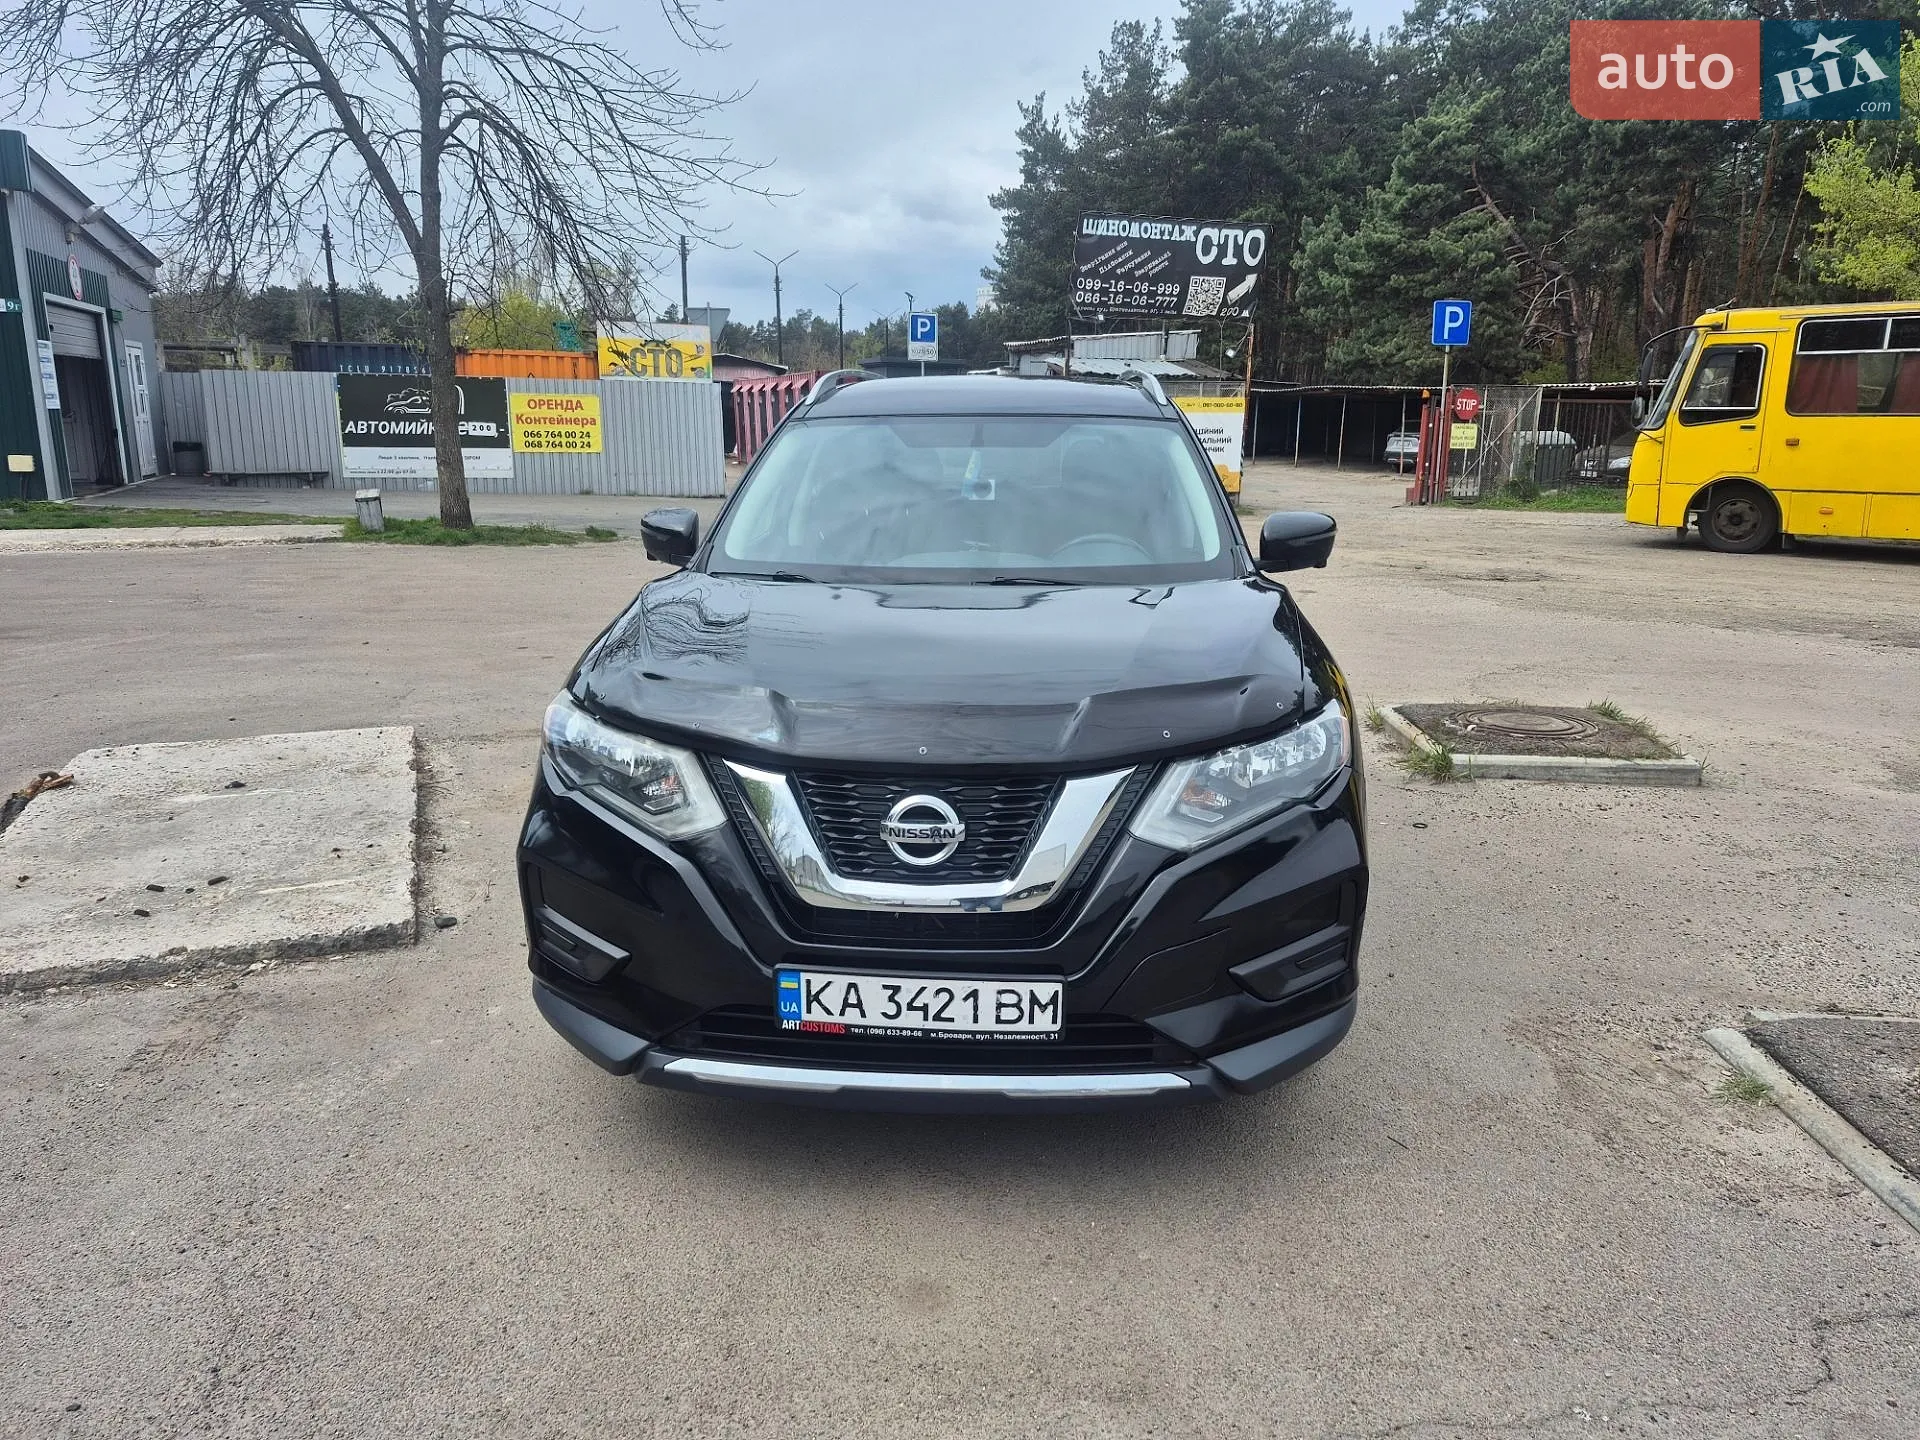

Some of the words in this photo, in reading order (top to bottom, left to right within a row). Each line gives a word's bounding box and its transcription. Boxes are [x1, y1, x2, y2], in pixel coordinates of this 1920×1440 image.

[1082, 218, 1196, 242] ШИНОМОНТАЖ
[1196, 227, 1266, 267] СТО
[1076, 278, 1180, 295] 099-16-06-999
[1076, 291, 1178, 308] 066-16-06-777
[1220, 306, 1240, 316] 200
[917, 317, 930, 340] P
[1443, 306, 1464, 340] P
[630, 346, 683, 378] СТО
[527, 398, 584, 412] ОРЕНДА
[1456, 398, 1477, 410] STOP
[345, 419, 435, 434] АВТОМИЙК
[515, 413, 596, 428] Контейнера
[523, 430, 542, 438] 066
[544, 430, 562, 438] 764
[1200, 436, 1232, 444] АЛЬНИЙ
[524, 440, 542, 448] 068
[545, 440, 563, 448] 764
[888, 827, 956, 839] NISSAN
[780, 1001, 799, 1014] UA
[805, 978, 866, 1018] KA
[880, 984, 978, 1024] 3421
[995, 989, 1059, 1024] BM
